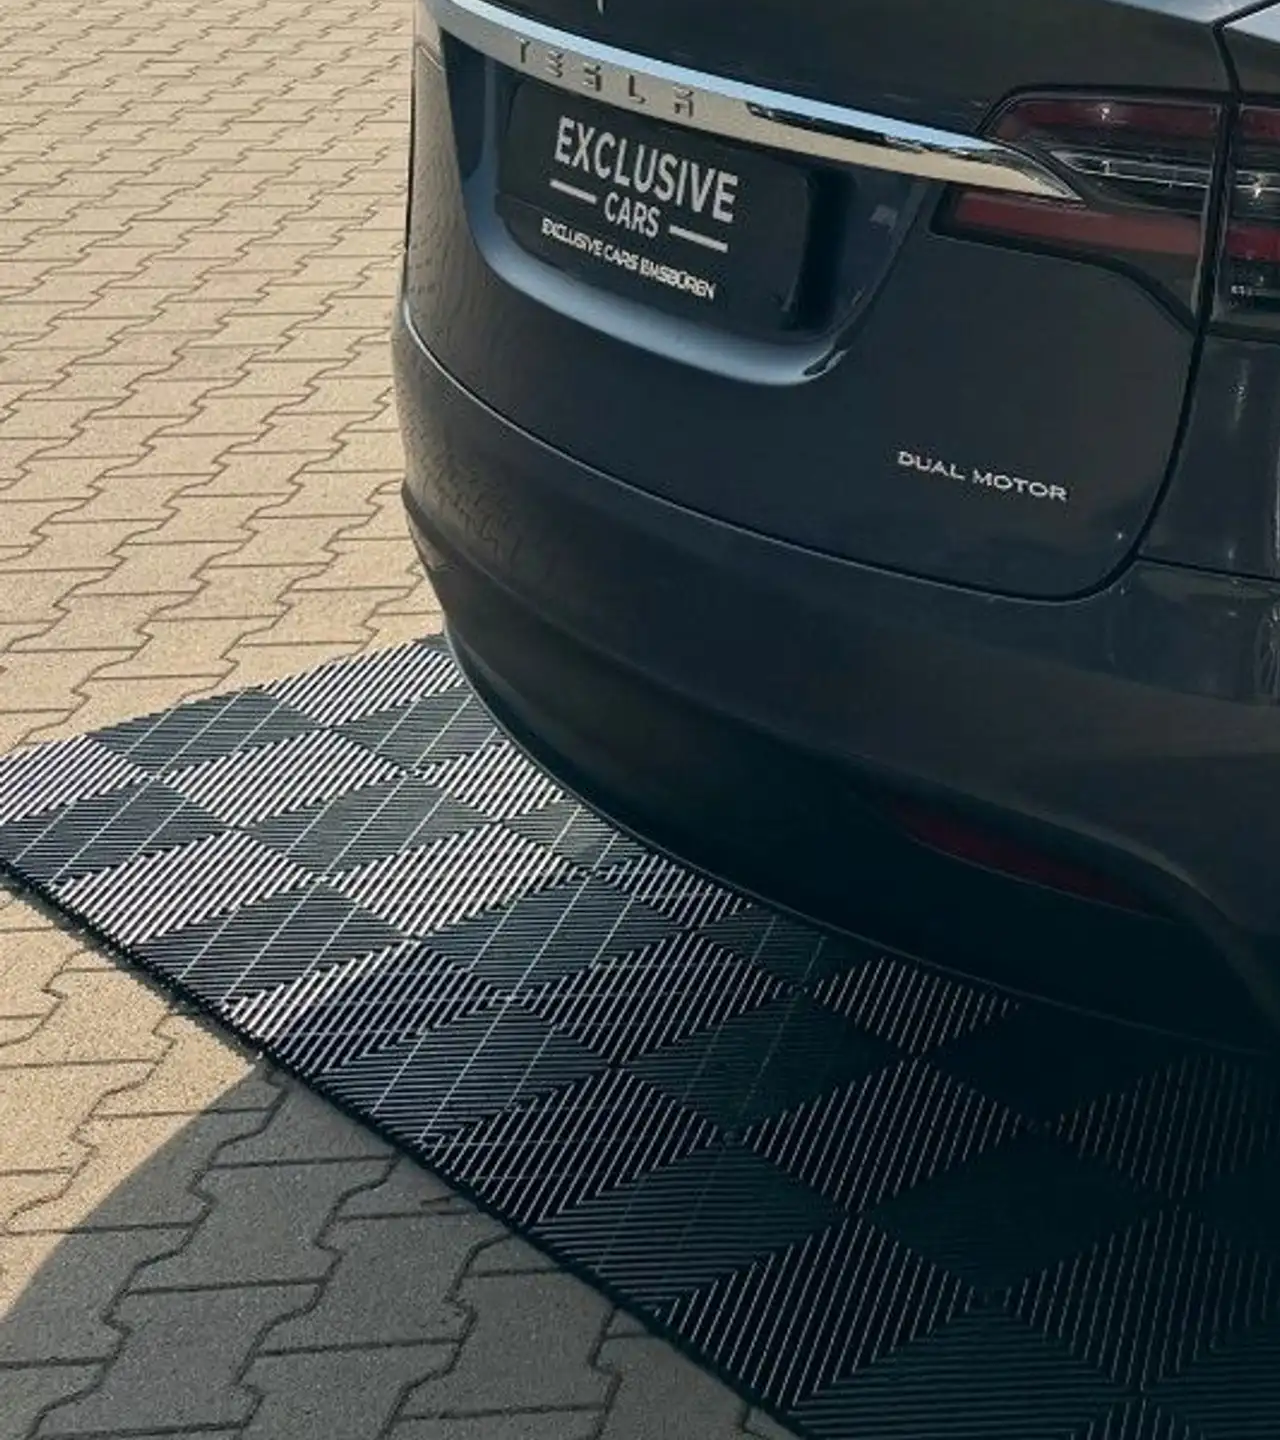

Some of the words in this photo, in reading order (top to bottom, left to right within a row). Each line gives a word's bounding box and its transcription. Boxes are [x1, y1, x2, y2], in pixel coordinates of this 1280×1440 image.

[516, 35, 695, 118] TESLA
[553, 115, 739, 224] EXCLUSIVE
[603, 191, 661, 239] CARS
[541, 217, 603, 258] EXCLUSIVE
[603, 244, 640, 271] CARS
[897, 451, 966, 481] DUAL
[971, 468, 1067, 502] MOTOR
